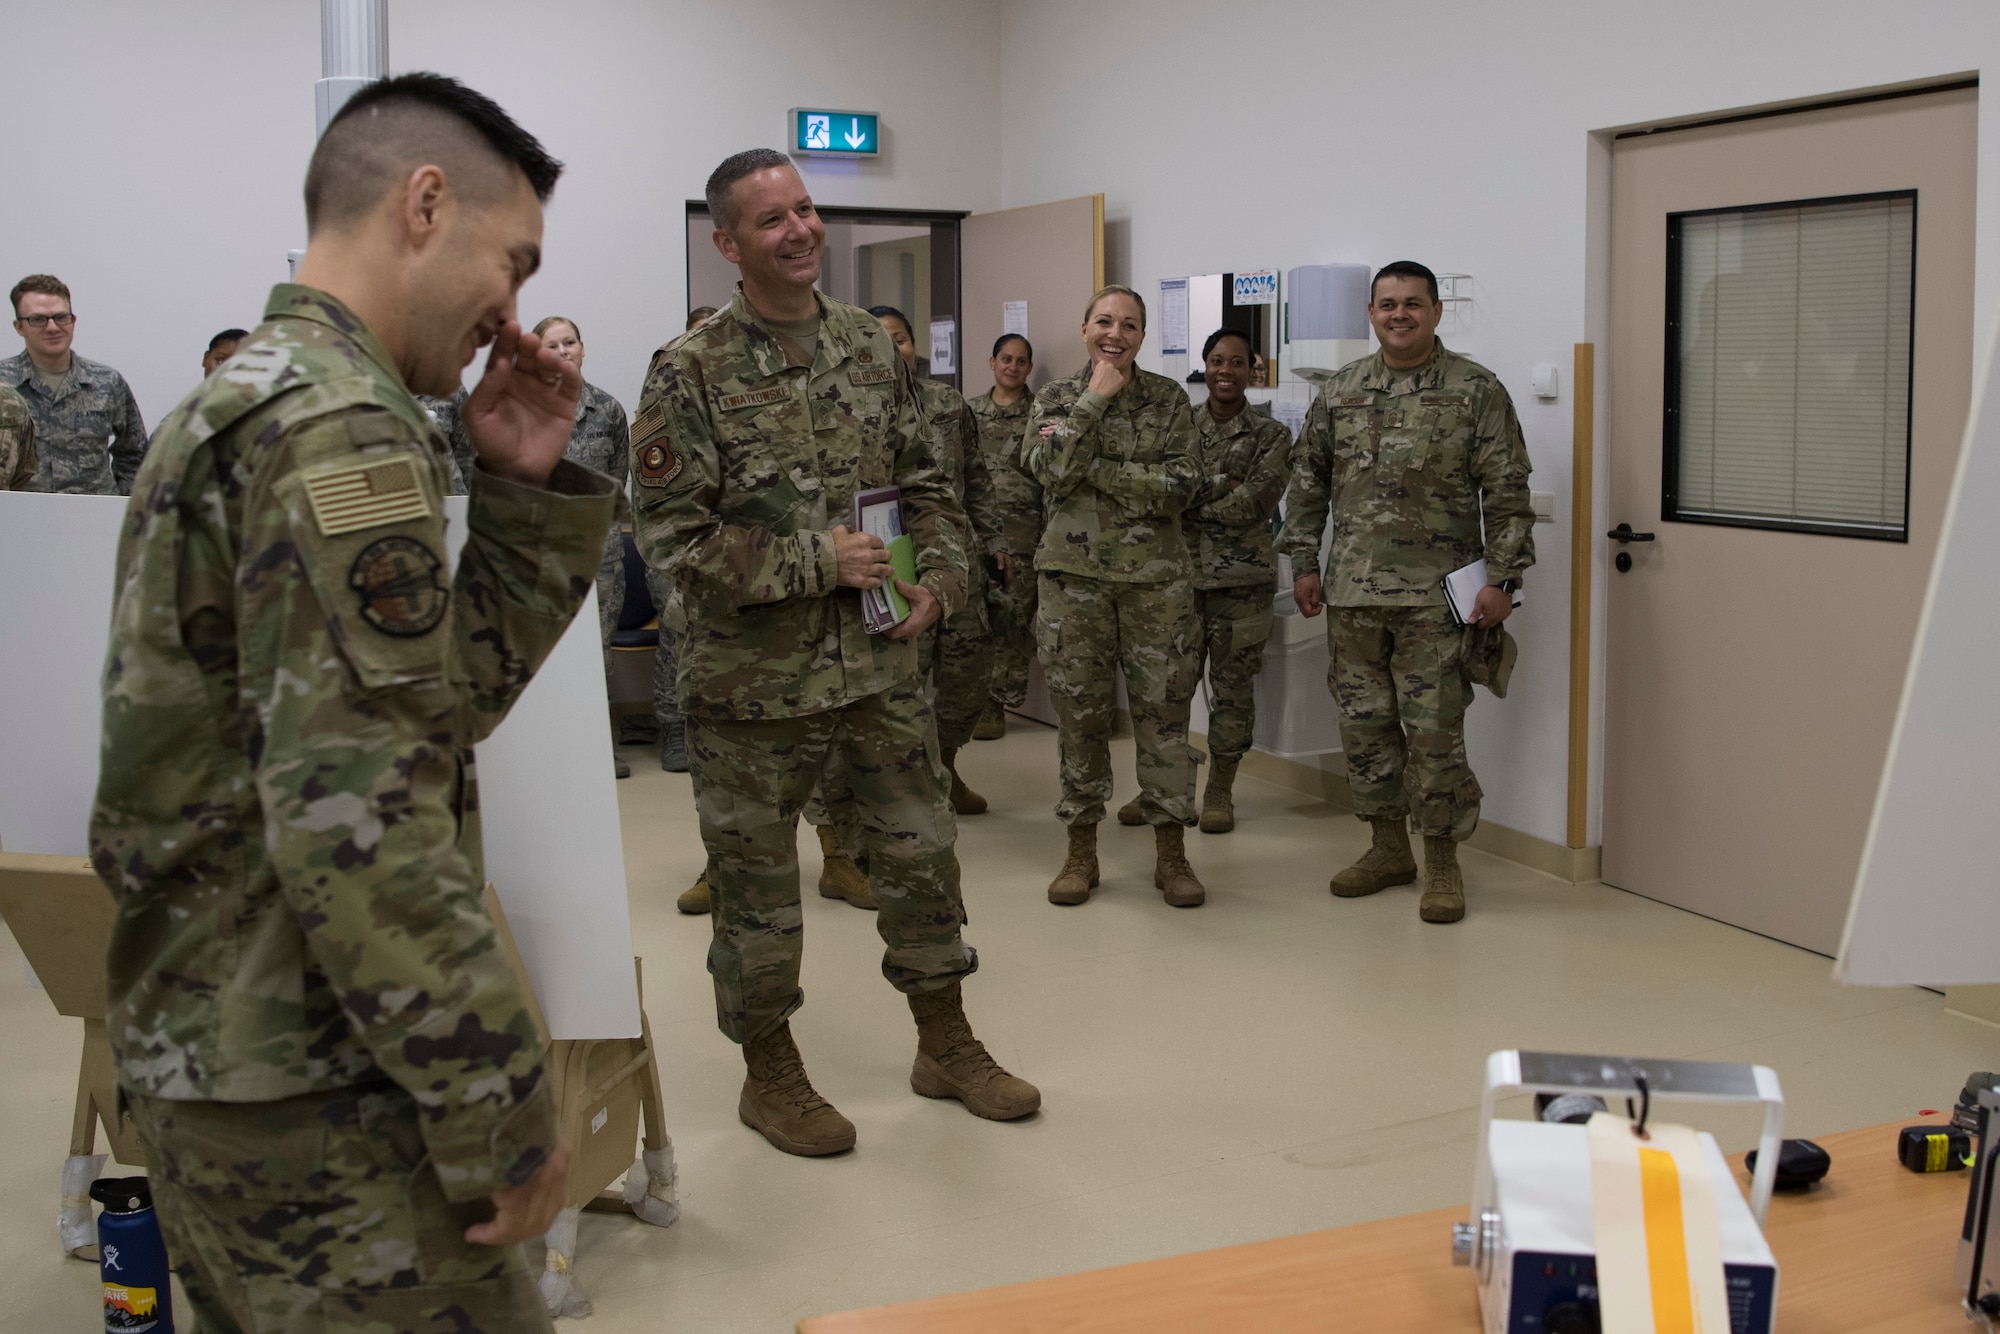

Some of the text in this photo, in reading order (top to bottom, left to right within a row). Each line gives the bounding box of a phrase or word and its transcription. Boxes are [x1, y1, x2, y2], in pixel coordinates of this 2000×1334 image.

[852, 368, 893, 382] US AIR FORCE
[722, 387, 786, 408] KWIATKOWSKI
[667, 461, 683, 480] FORCE
